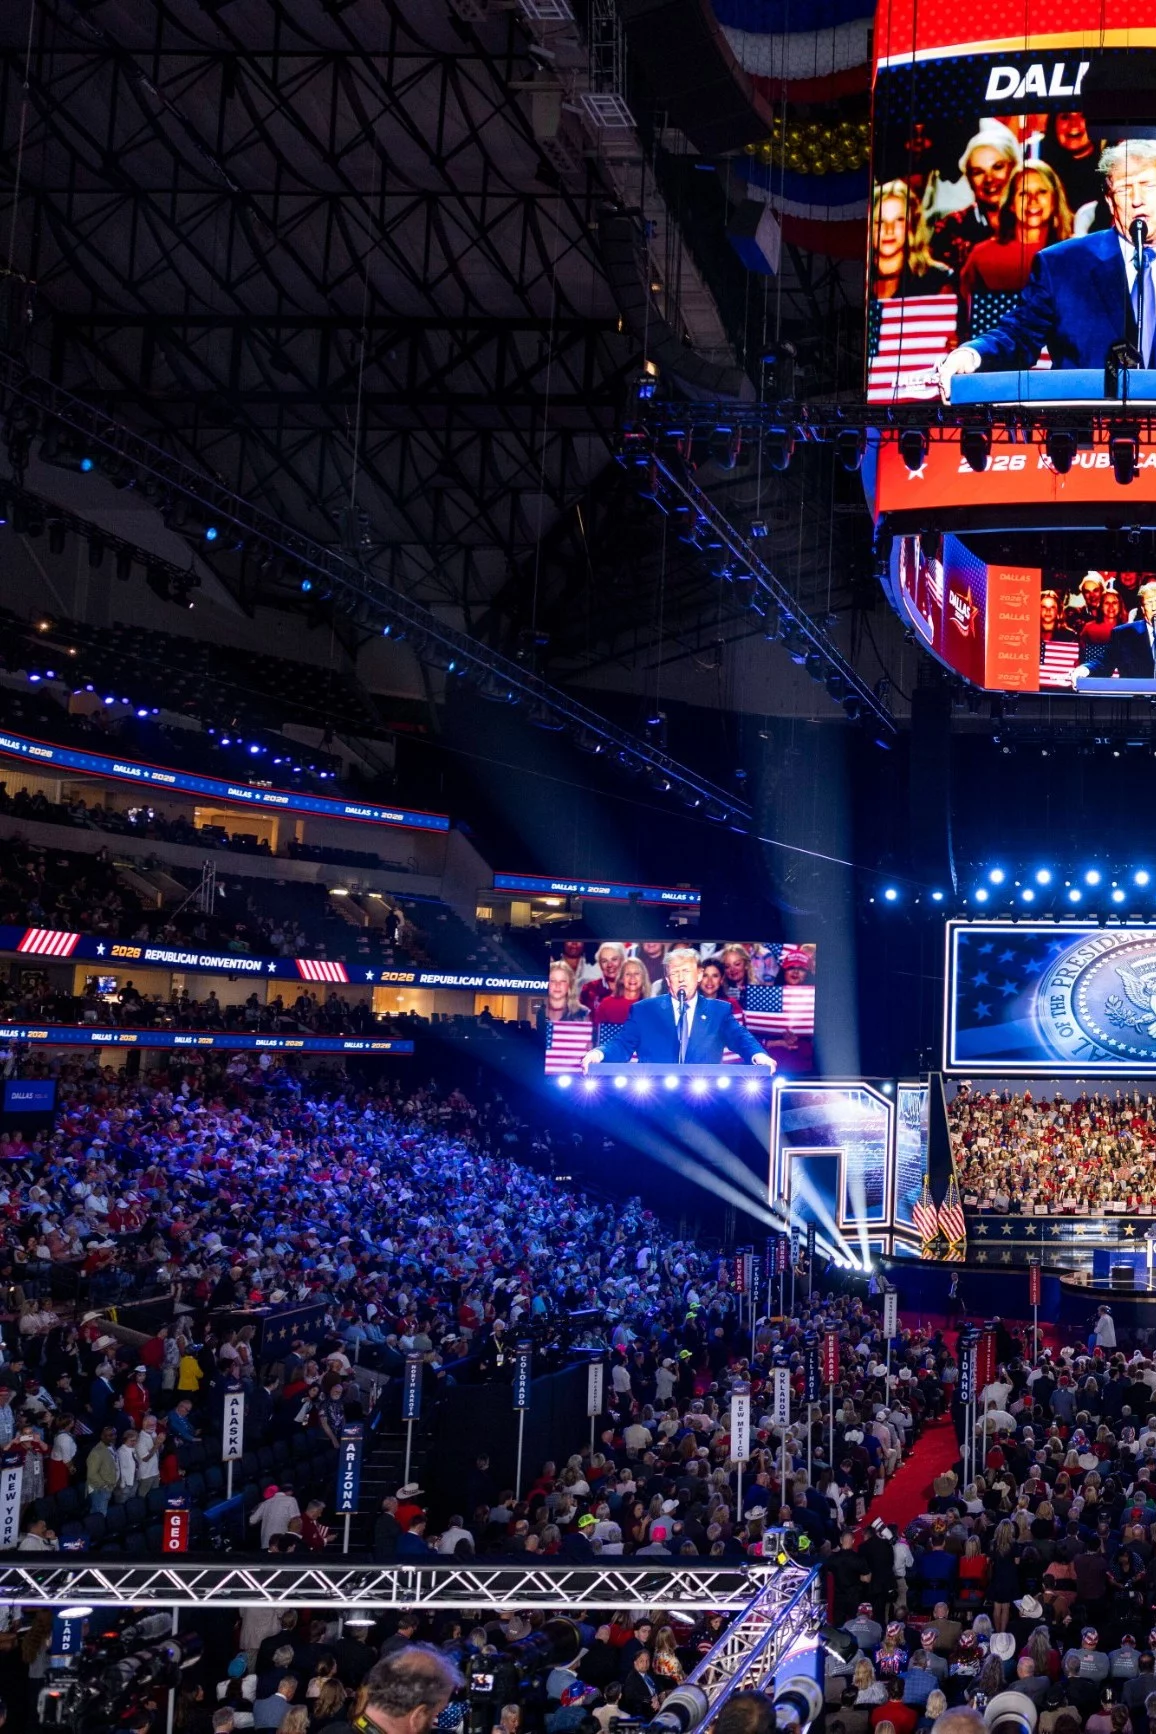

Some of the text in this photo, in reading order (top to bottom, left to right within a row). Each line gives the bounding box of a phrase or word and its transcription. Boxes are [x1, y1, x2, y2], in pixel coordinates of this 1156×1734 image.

[985, 61, 1090, 101] DAL
[957, 454, 1027, 474] 226
[1000, 573, 1031, 582] DALLAS
[949, 589, 971, 620] DALLAS
[999, 612, 1030, 621] DALLAS
[998, 651, 1029, 660] DALLAS
[28, 745, 53, 758] 2026
[112, 763, 141, 777] DALLAS
[227, 787, 252, 799] DALLAS
[344, 806, 371, 816] DALLAS
[551, 882, 578, 892] DALLAS
[662, 892, 687, 901] DALLAS
[111, 944, 263, 971] 2026 REPUBLICAN CONVENTION
[380, 971, 549, 990] 2026 REPUBLICAN CONVENTION
[1050, 994, 1066, 1019] THE
[91, 1033, 112, 1041] DALLAS
[1053, 1021, 1074, 1038] OF
[174, 1036, 192, 1044] DALLAS
[255, 1039, 277, 1047] DALLAS
[343, 1041, 364, 1049] DALLAS
[11, 1091, 33, 1099] DALLAS
[518, 1355, 527, 1406] COLORADO
[961, 1351, 969, 1400] IDAHO
[408, 1389, 416, 1417] DAKOTA
[228, 1398, 240, 1455] ALASKA
[736, 1400, 745, 1458] NEW MEXICO
[342, 1443, 356, 1509] ARIZONA
[6, 1473, 17, 1501] NEW
[3, 1507, 14, 1544] YORK
[61, 1619, 72, 1651] LAND
